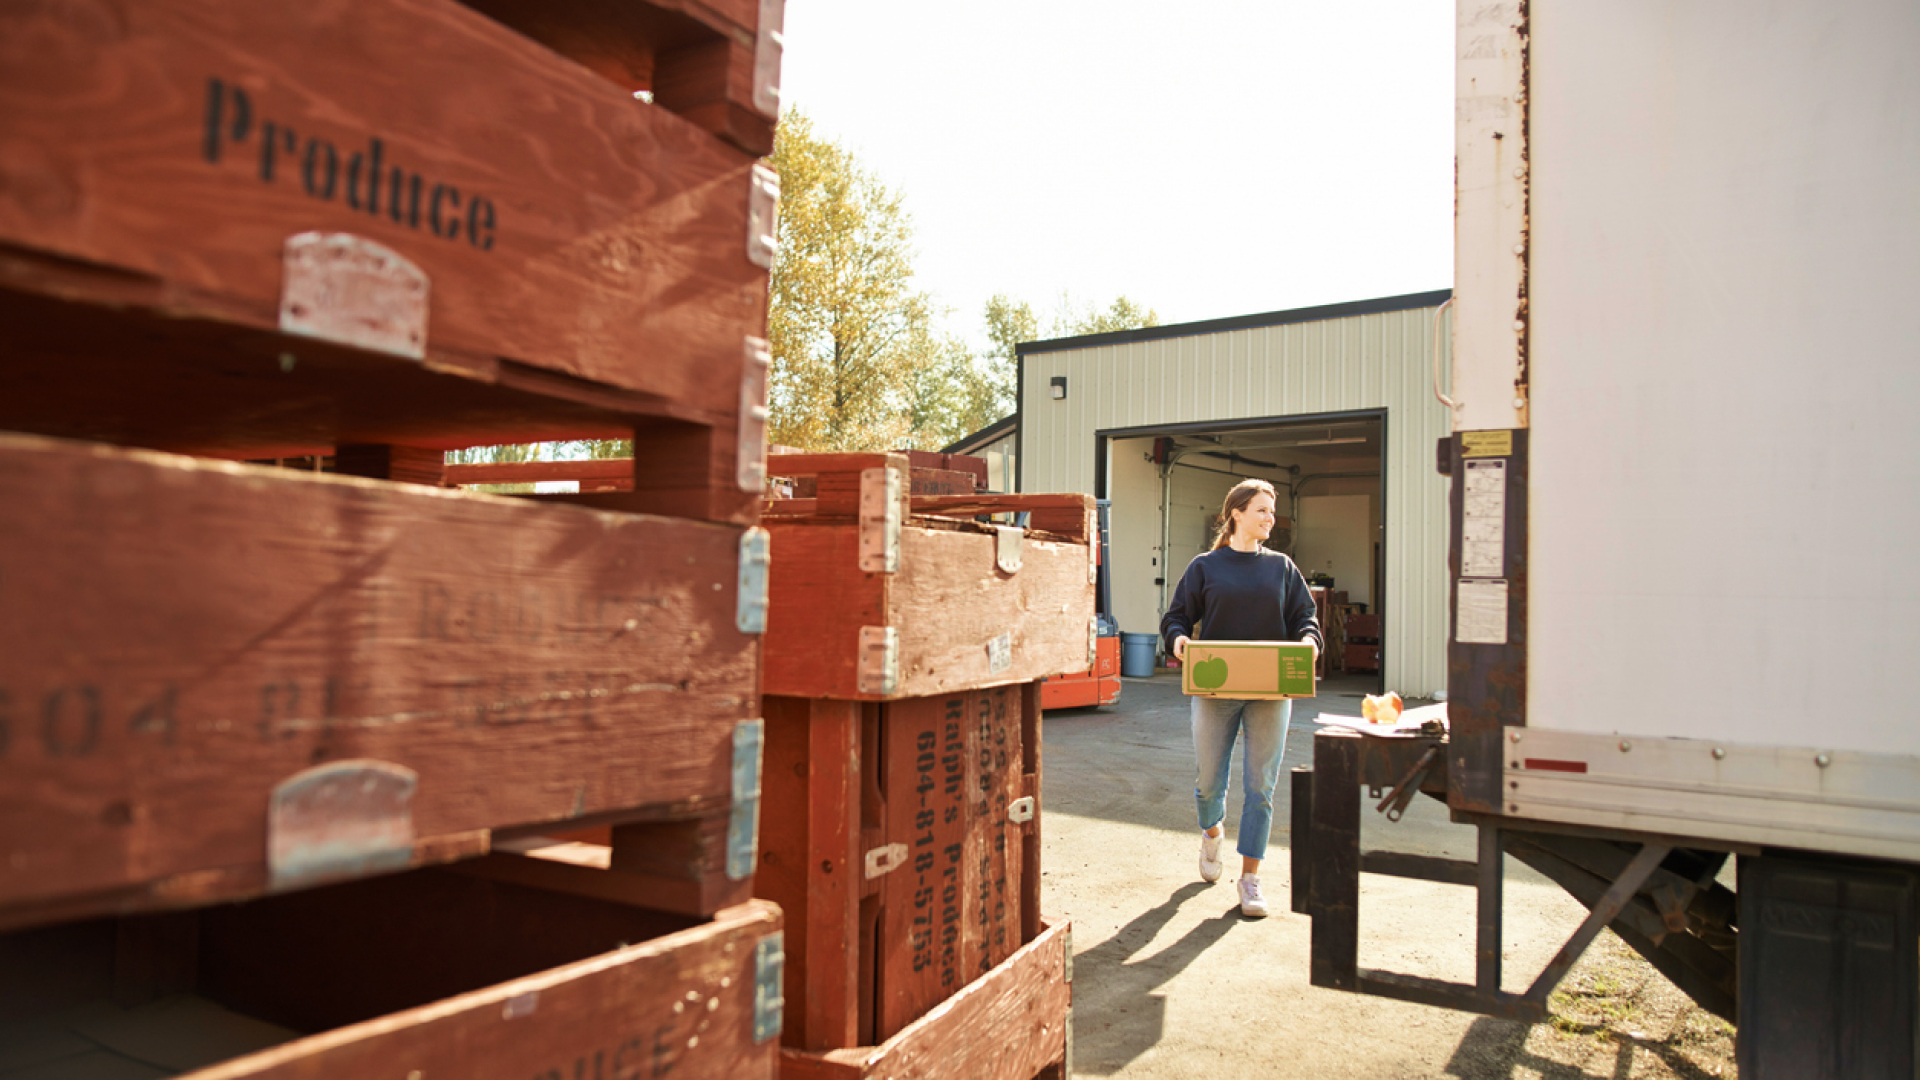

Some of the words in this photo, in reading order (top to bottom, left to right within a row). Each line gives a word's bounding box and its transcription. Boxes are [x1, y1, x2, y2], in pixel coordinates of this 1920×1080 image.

[203, 77, 497, 251] Produce
[942, 699, 963, 824] Ralph's
[913, 730, 936, 974] 604-818-5753
[941, 842, 961, 987] Produce
